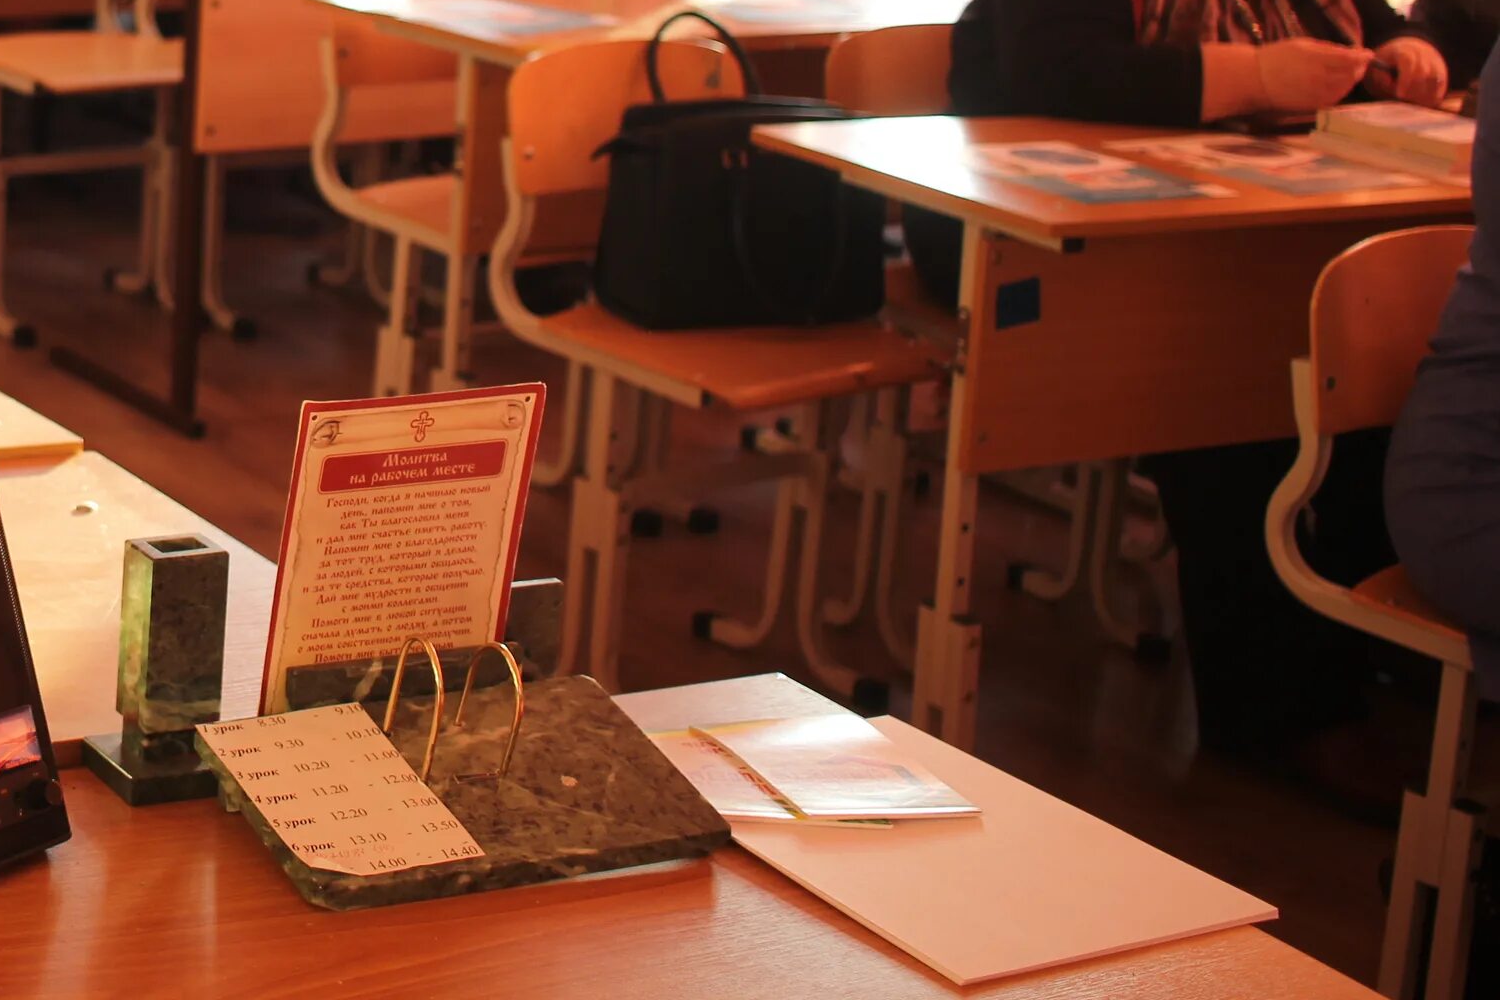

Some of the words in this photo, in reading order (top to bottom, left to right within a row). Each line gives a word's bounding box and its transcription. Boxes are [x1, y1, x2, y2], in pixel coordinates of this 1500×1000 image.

[383, 452, 448, 468] Молитва
[350, 474, 366, 485] на
[371, 469, 428, 486] рабочем
[433, 464, 476, 476] месте
[373, 494, 401, 504] когда
[415, 489, 458, 499] начинаю
[461, 484, 491, 494] новый
[372, 505, 414, 516] напомни
[418, 502, 436, 510] мне
[340, 522, 357, 530] как
[362, 518, 378, 529] Ты
[381, 514, 440, 526] благословил
[445, 511, 469, 520] меня
[324, 545, 369, 556] Напомни
[373, 542, 392, 550] мне
[405, 534, 477, 547] благодарности
[326, 535, 344, 545] дал
[348, 533, 368, 541] мне
[372, 529, 412, 539] счастье
[415, 525, 447, 535] иметь
[319, 560, 331, 569] за
[336, 557, 355, 566] тот
[389, 549, 431, 560] который
[377, 562, 428, 573] которыми
[313, 585, 325, 593] за
[329, 582, 342, 590] те
[398, 572, 439, 583] которые
[316, 594, 336, 605] Дай
[341, 593, 359, 601] мне
[364, 588, 412, 599] мудрости
[425, 582, 469, 592] общении
[351, 602, 384, 611] моими
[387, 596, 438, 607] коллегами
[311, 618, 349, 628] Помоги
[352, 615, 372, 623] мне
[386, 609, 416, 620] любой
[420, 604, 467, 616] ситуации
[301, 631, 340, 641] сначала
[343, 626, 382, 638] думать
[442, 616, 472, 625] потом
[337, 636, 400, 649] собственном
[314, 653, 353, 664] Помоги
[356, 650, 375, 659] мне
[203, 725, 208, 733] 1
[213, 723, 244, 735] урок
[257, 716, 287, 728] 8.30
[334, 704, 366, 716] 9.10
[219, 748, 227, 757] 2
[230, 746, 262, 758] урок
[274, 738, 305, 751] 9.30
[346, 727, 381, 740] 10.10
[236, 771, 244, 780] 3
[247, 768, 280, 781] урок
[293, 760, 330, 774] 10.20
[364, 750, 400, 763] 11.00
[254, 795, 262, 804] 4
[265, 792, 299, 805] урок
[311, 784, 350, 797] 11.20
[382, 773, 419, 785] 12.00
[273, 818, 280, 828] 5
[284, 817, 317, 830] урок
[329, 808, 369, 822] 12.20
[401, 796, 439, 809] 13.00
[291, 842, 301, 852] 6
[302, 841, 337, 854] урок
[349, 831, 388, 847] 13.10
[420, 819, 459, 834] 13.50
[369, 857, 408, 870] 14.00
[440, 845, 480, 859] 14.40
